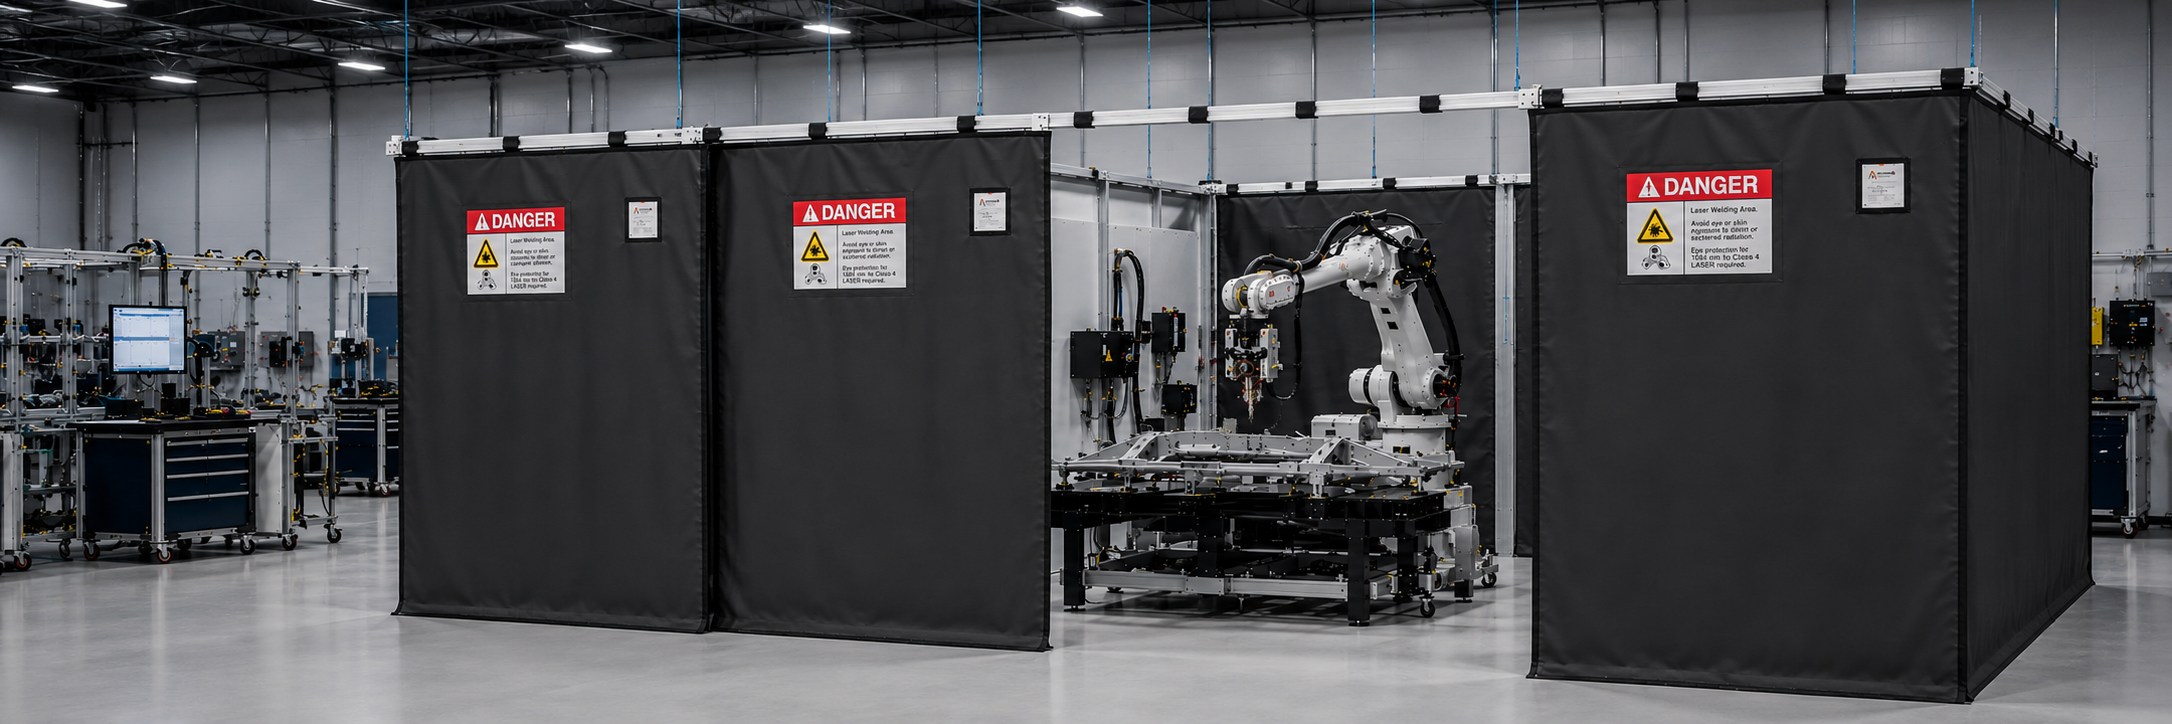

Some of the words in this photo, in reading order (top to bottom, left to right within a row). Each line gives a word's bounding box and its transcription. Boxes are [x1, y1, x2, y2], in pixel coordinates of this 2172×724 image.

[1665, 176, 1758, 196] DANGER
[822, 203, 895, 220] DANGER
[493, 212, 555, 229] DANGER
